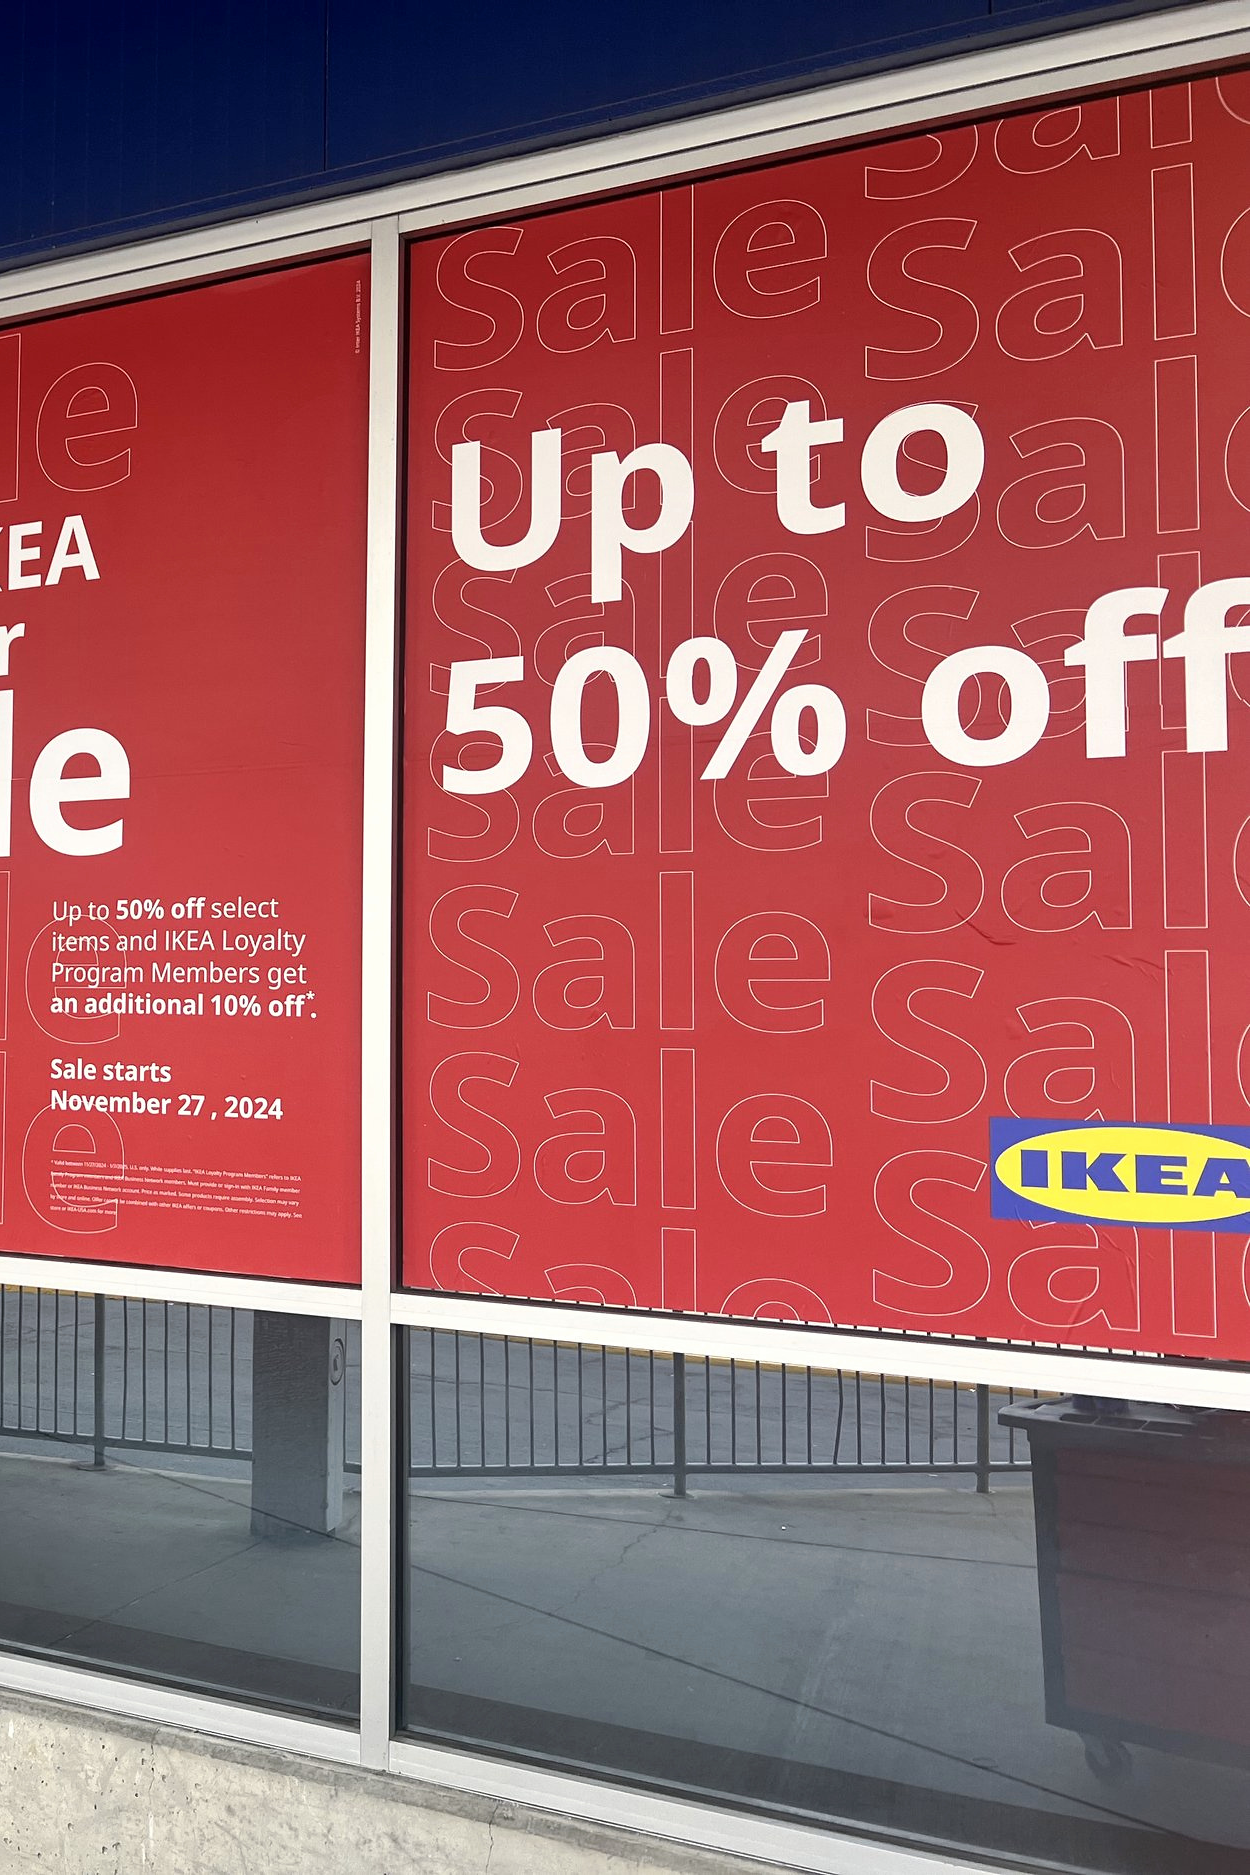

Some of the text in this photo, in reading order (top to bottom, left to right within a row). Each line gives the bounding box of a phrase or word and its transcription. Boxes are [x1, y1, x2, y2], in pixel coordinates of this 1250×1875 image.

[433, 184, 829, 371] Sale
[864, 162, 1250, 381] Sal
[452, 400, 986, 604] Up to
[442, 577, 1250, 795] 50% off
[867, 750, 1250, 934] Sal
[52, 928, 306, 957] items and IKEA Loyalty
[53, 896, 279, 926] Up to 50% off select
[426, 871, 831, 1034] Sale
[50, 996, 78, 1014] an
[84, 993, 204, 1015] additional
[211, 994, 262, 1017] 10%
[51, 961, 307, 990] Program Members get
[50, 1058, 172, 1082] Sale starts
[869, 950, 1250, 1125] Sal
[50, 1089, 283, 1120] November 27 2024
[427, 1048, 834, 1218] Sale
[205, 1169, 222, 1177] Loyalty
[1020, 1149, 1250, 1199] IKEA
